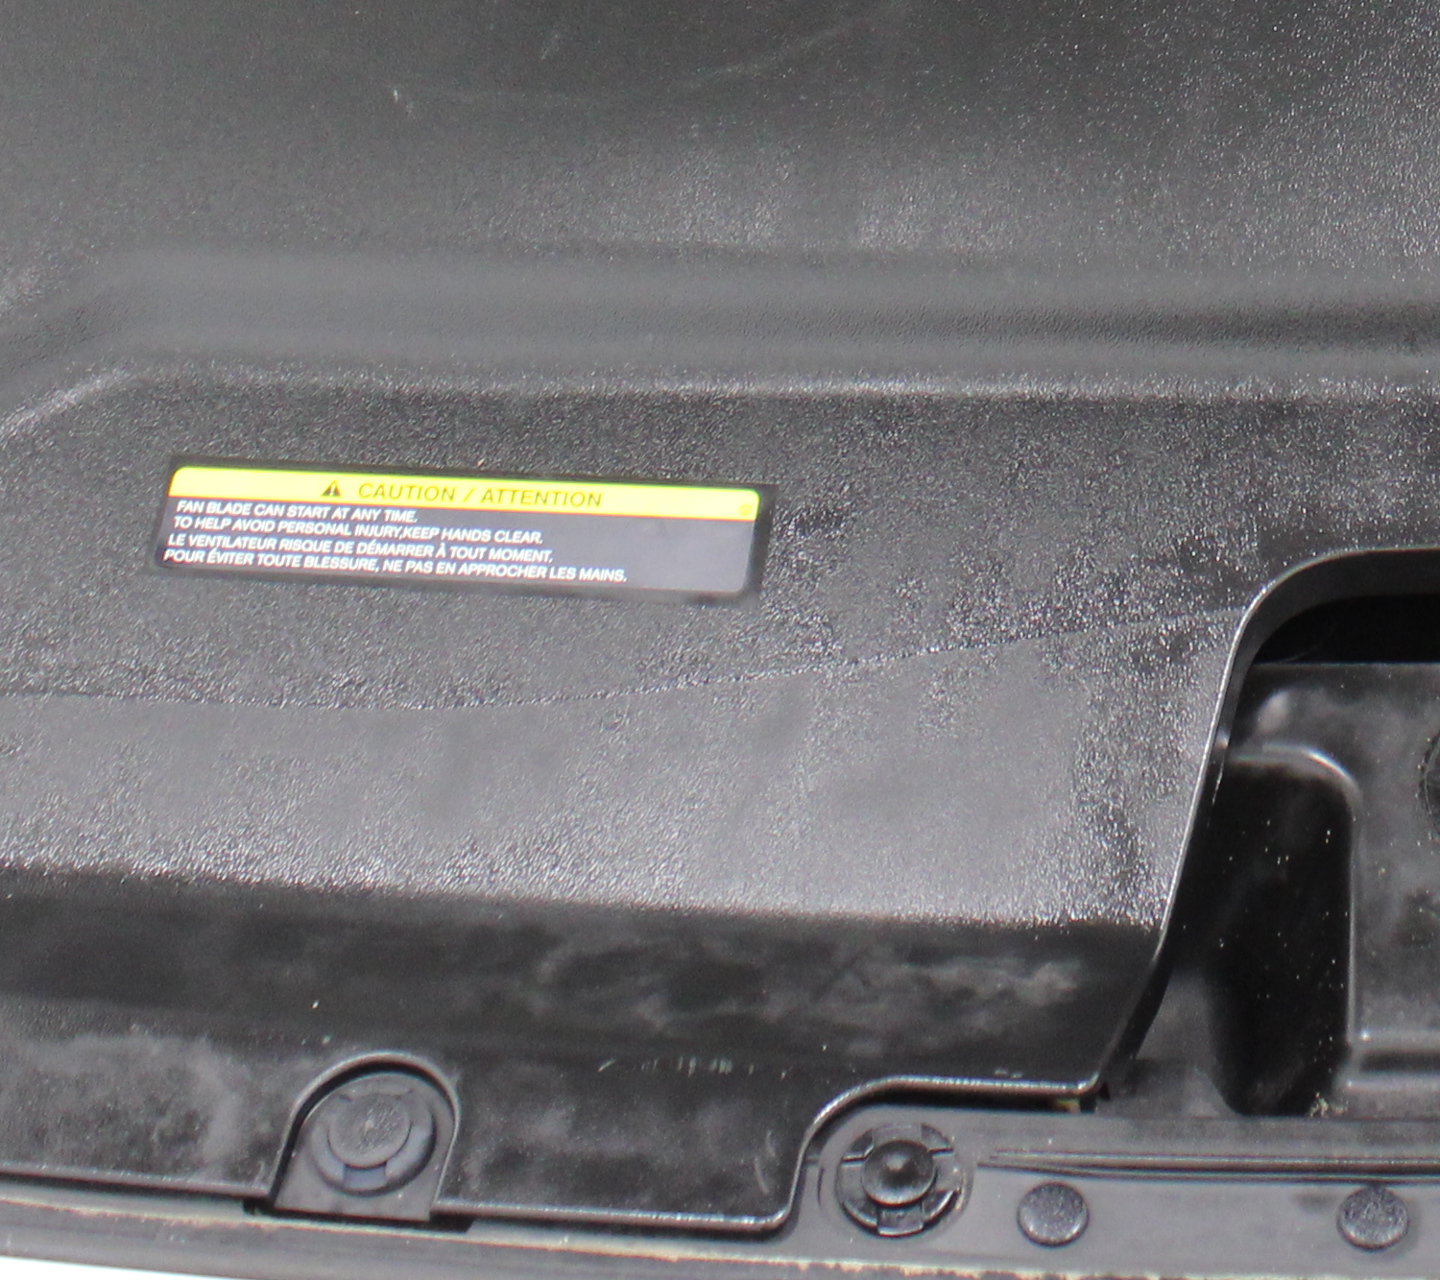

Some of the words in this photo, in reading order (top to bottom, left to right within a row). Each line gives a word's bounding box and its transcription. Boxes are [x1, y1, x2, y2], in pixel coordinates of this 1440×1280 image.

[359, 483, 458, 502] CAUTION
[481, 488, 603, 507] ATTENTION
[176, 500, 205, 513] FAN
[206, 501, 253, 515] BLADE
[254, 503, 285, 517] CAN
[287, 505, 332, 519] START
[332, 507, 351, 520] AT
[351, 508, 382, 522] ANY
[174, 516, 192, 529] TO
[194, 517, 232, 530] HELP
[232, 519, 276, 533] AVOID
[277, 520, 352, 536] PERSONAL
[441, 528, 491, 542] HANDS
[168, 533, 186, 546] LE
[188, 534, 277, 550] VENTILATEUR
[278, 538, 332, 553] RISQUE
[334, 541, 355, 554] DE
[356, 539, 434, 557] DÉMARRER
[435, 542, 447, 558] À
[450, 546, 487, 560] TOUT
[162, 549, 205, 563] POUR
[206, 547, 254, 565] ÉVITER
[257, 554, 301, 568] TOUTE
[304, 555, 380, 573] BLESSURE,
[382, 559, 403, 573] NE
[405, 560, 433, 574] PAS
[435, 562, 456, 575] EN
[458, 563, 547, 579] APPROCHER
[549, 566, 577, 580] LES
